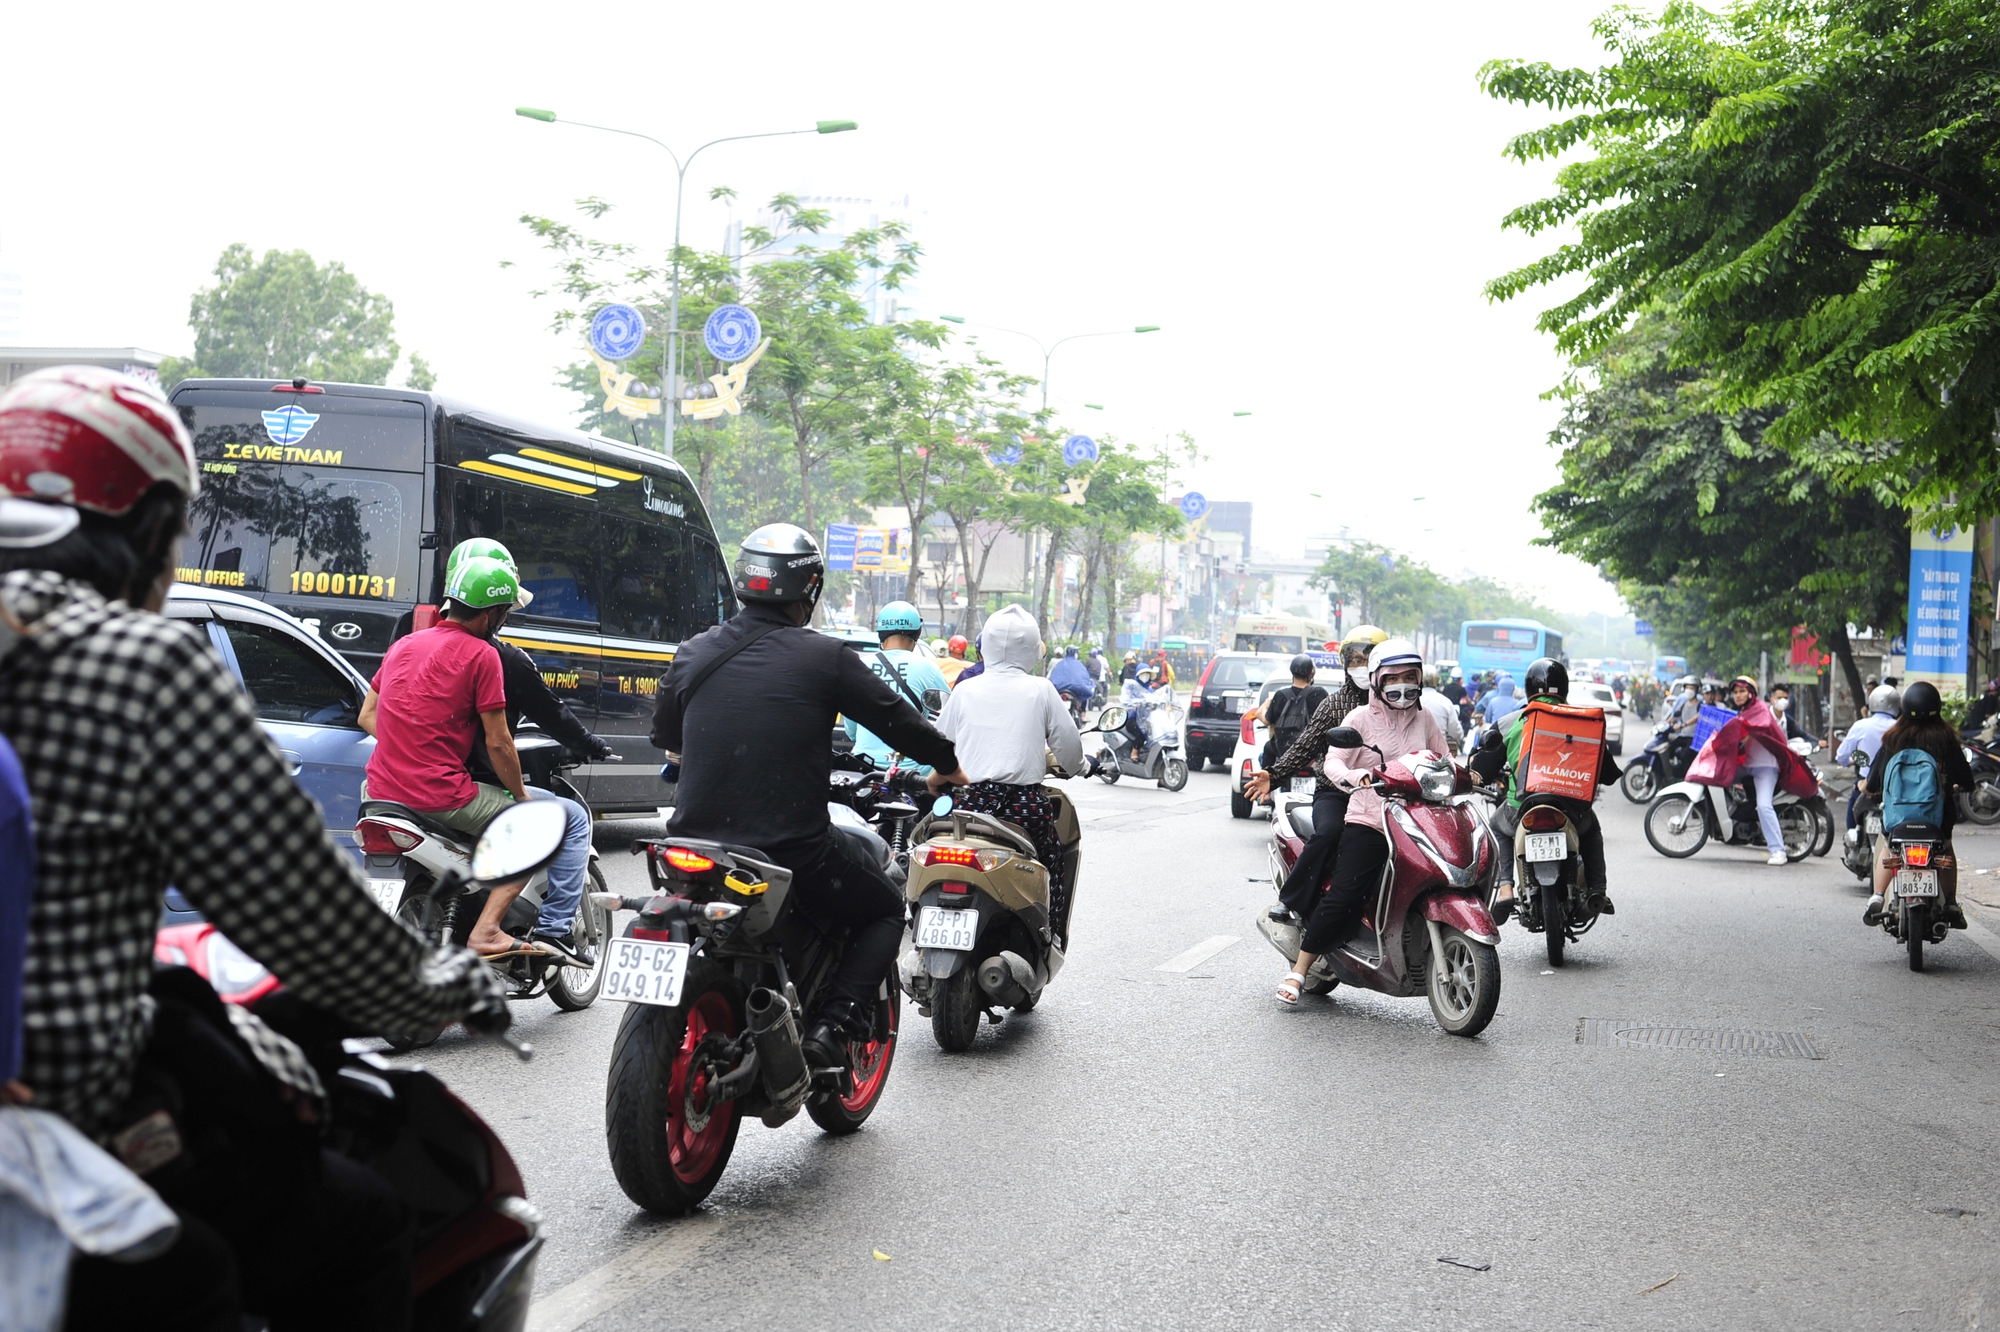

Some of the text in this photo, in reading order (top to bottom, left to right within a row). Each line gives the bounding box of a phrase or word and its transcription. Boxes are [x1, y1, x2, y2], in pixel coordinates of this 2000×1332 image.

[174, 567, 245, 587] KING OFFICE
[290, 571, 396, 597] 19001731
[486, 583, 512, 598] Grab
[543, 670, 579, 689] NH PHÚC
[618, 676, 659, 694] Tel. 19001
[1533, 764, 1591, 782] LALAMOVE
[1912, 872, 1923, 882] 29
[928, 911, 969, 929] 29-P1
[921, 928, 971, 947] 486.03
[618, 944, 676, 973] 59-G2
[608, 971, 674, 1001] 949.14
